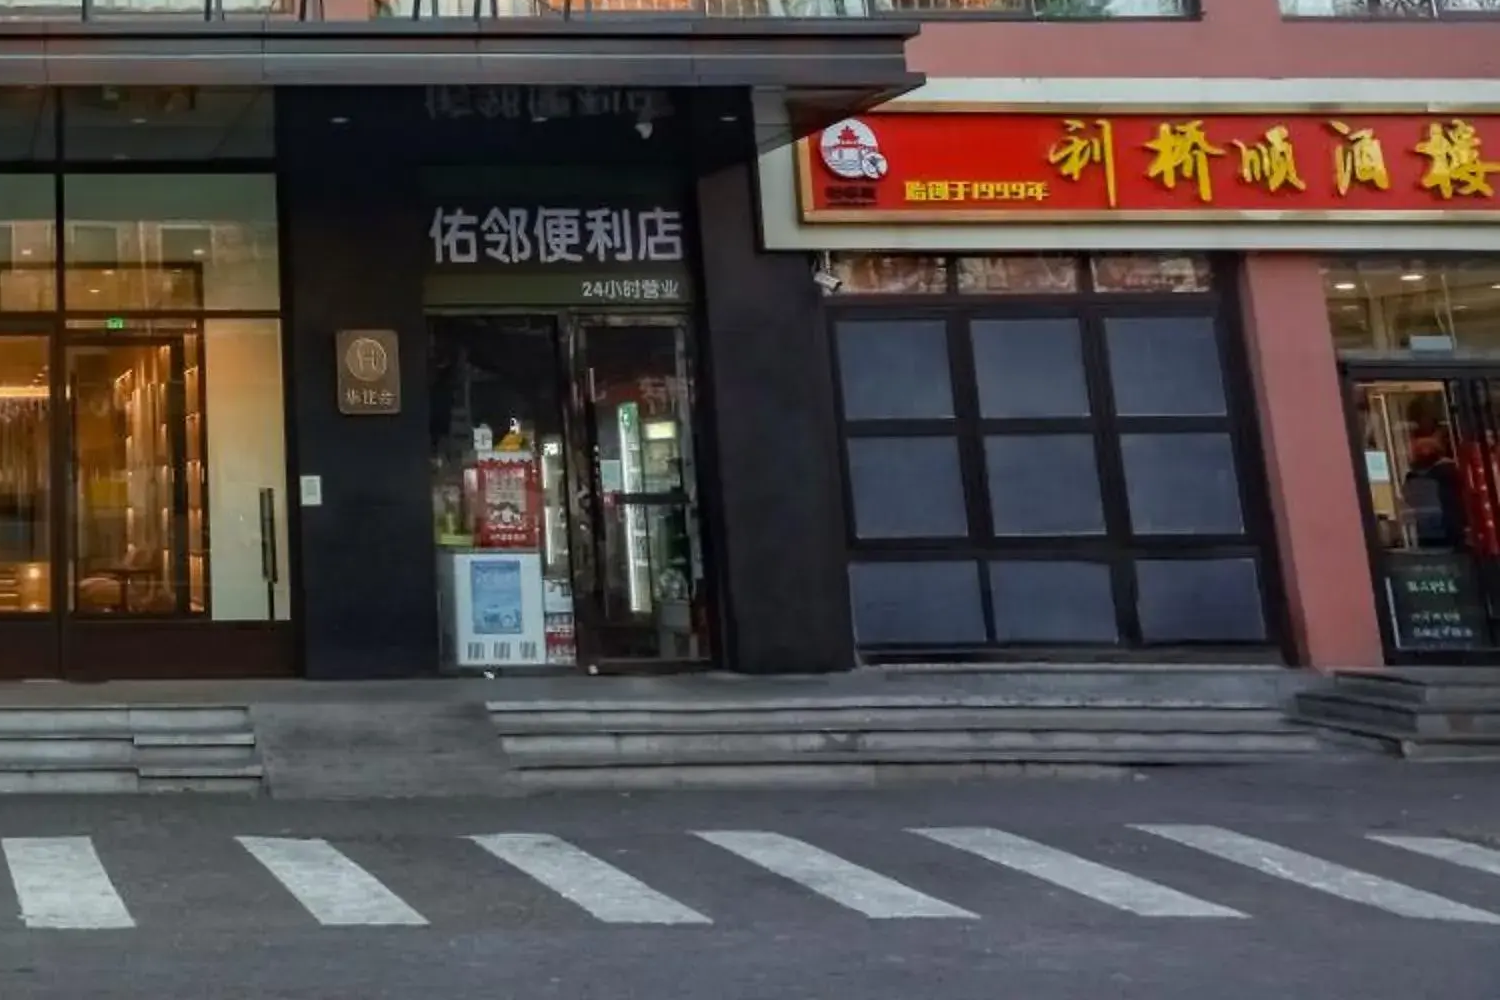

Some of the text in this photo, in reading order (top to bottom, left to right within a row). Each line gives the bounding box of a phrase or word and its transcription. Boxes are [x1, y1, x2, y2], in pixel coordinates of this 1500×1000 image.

[428, 205, 684, 264] 佑邻便利店
[581, 279, 679, 299] 24小时营业
